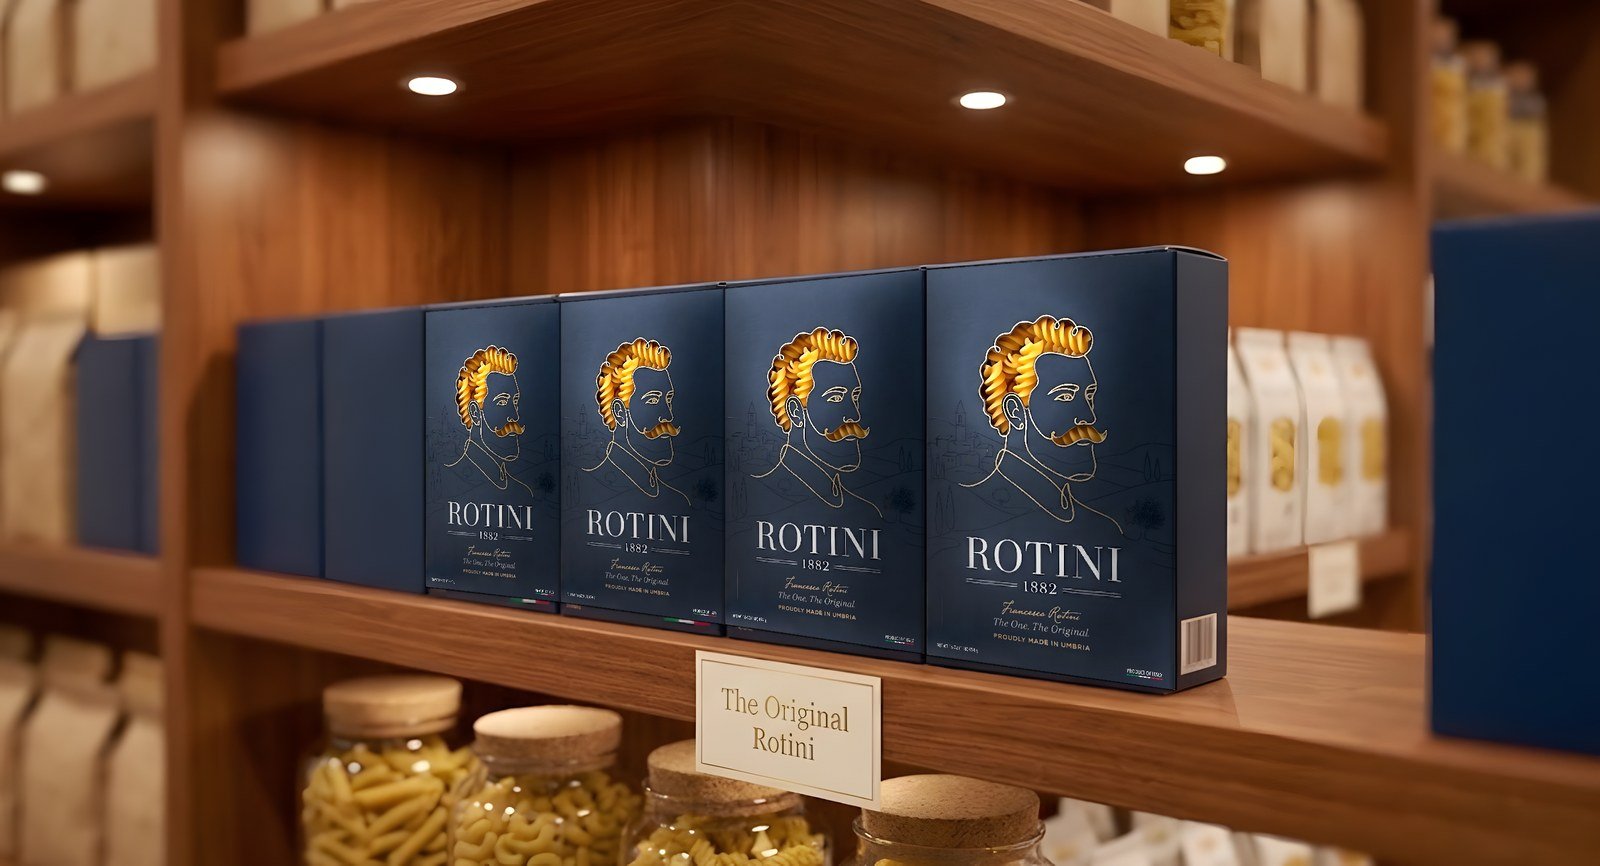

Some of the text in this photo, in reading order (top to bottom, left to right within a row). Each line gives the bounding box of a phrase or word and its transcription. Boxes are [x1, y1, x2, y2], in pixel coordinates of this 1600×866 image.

[448, 501, 534, 531] ROTINI
[479, 531, 499, 541] 1882
[586, 509, 691, 544] ROTINI
[625, 543, 648, 554] 1882
[756, 520, 882, 561] ROTINI
[802, 558, 830, 572] 1882
[965, 536, 1122, 583] ROTINI
[649, 589, 671, 597] UMBRIA
[784, 575, 849, 597] Francesco Rotini
[1023, 580, 1058, 595] 1882
[777, 591, 791, 600] The
[809, 595, 822, 604] The
[777, 604, 805, 613] PROUDLY
[805, 608, 823, 616] MADE
[832, 612, 857, 620] UMBRIA
[1001, 599, 1082, 624] Francesco Rotini
[994, 617, 1009, 628] The
[1010, 620, 1030, 630] One.
[1030, 622, 1049, 633] The
[993, 632, 1026, 643] PROUDLY
[1028, 637, 1049, 646] MADE
[1060, 642, 1091, 651] UMBRIA
[721, 687, 849, 732] The Original
[752, 726, 815, 761] Rotini
